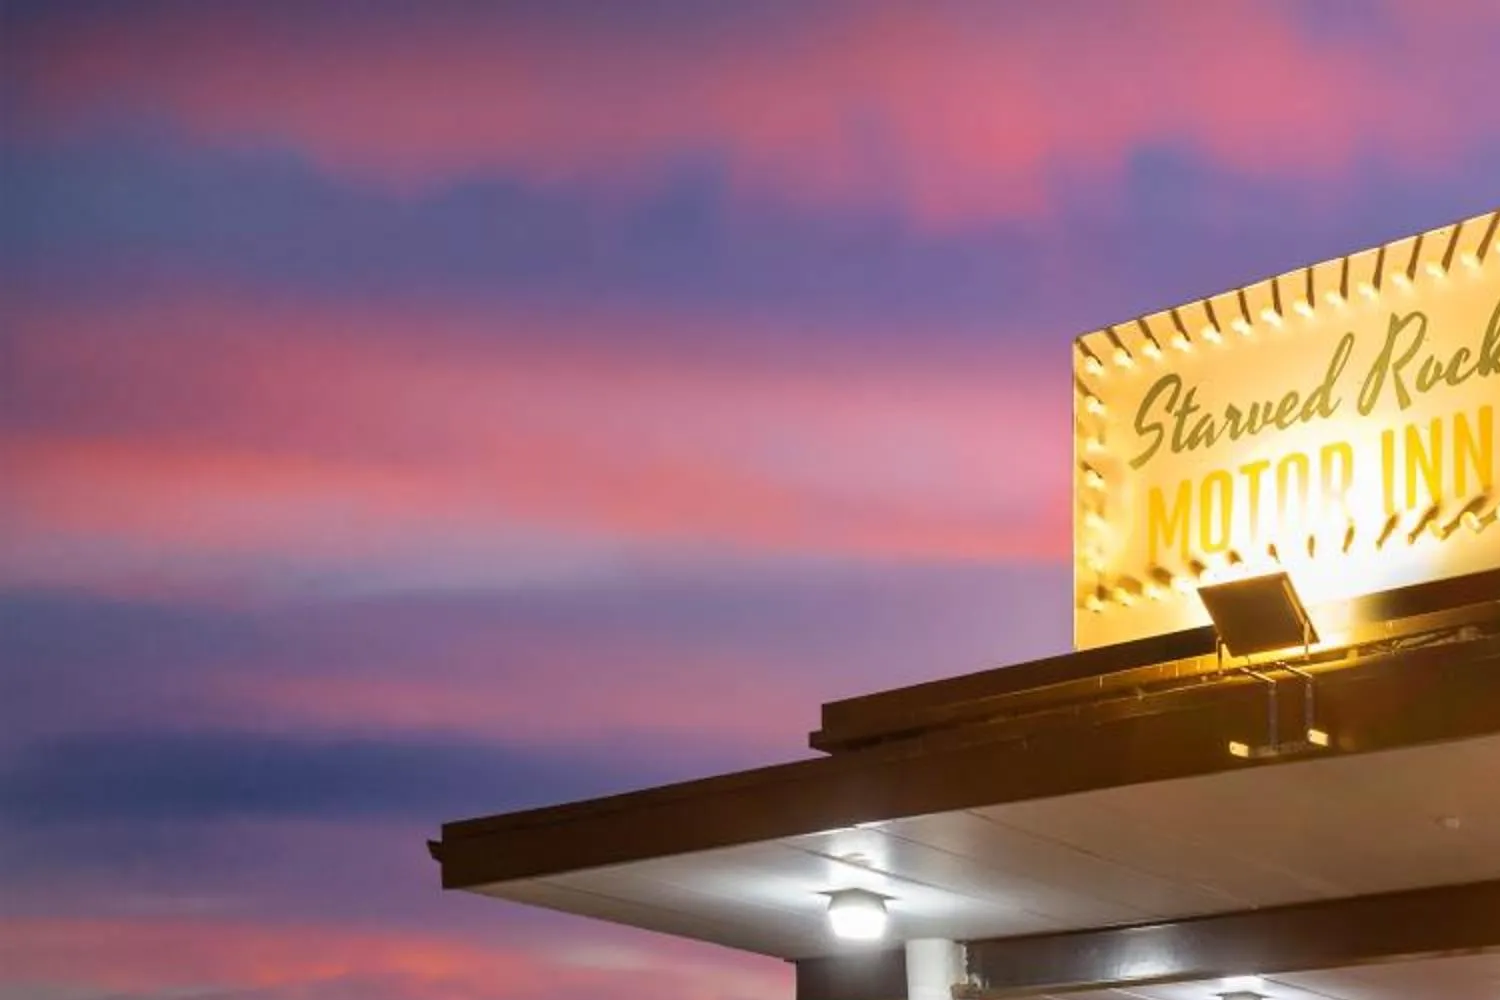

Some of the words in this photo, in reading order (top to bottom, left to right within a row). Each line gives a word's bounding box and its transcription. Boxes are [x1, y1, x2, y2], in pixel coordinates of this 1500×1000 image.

[1128, 332, 1356, 471] Starved
[1146, 441, 1354, 564] MOTOR
[1380, 404, 1494, 518] INN
